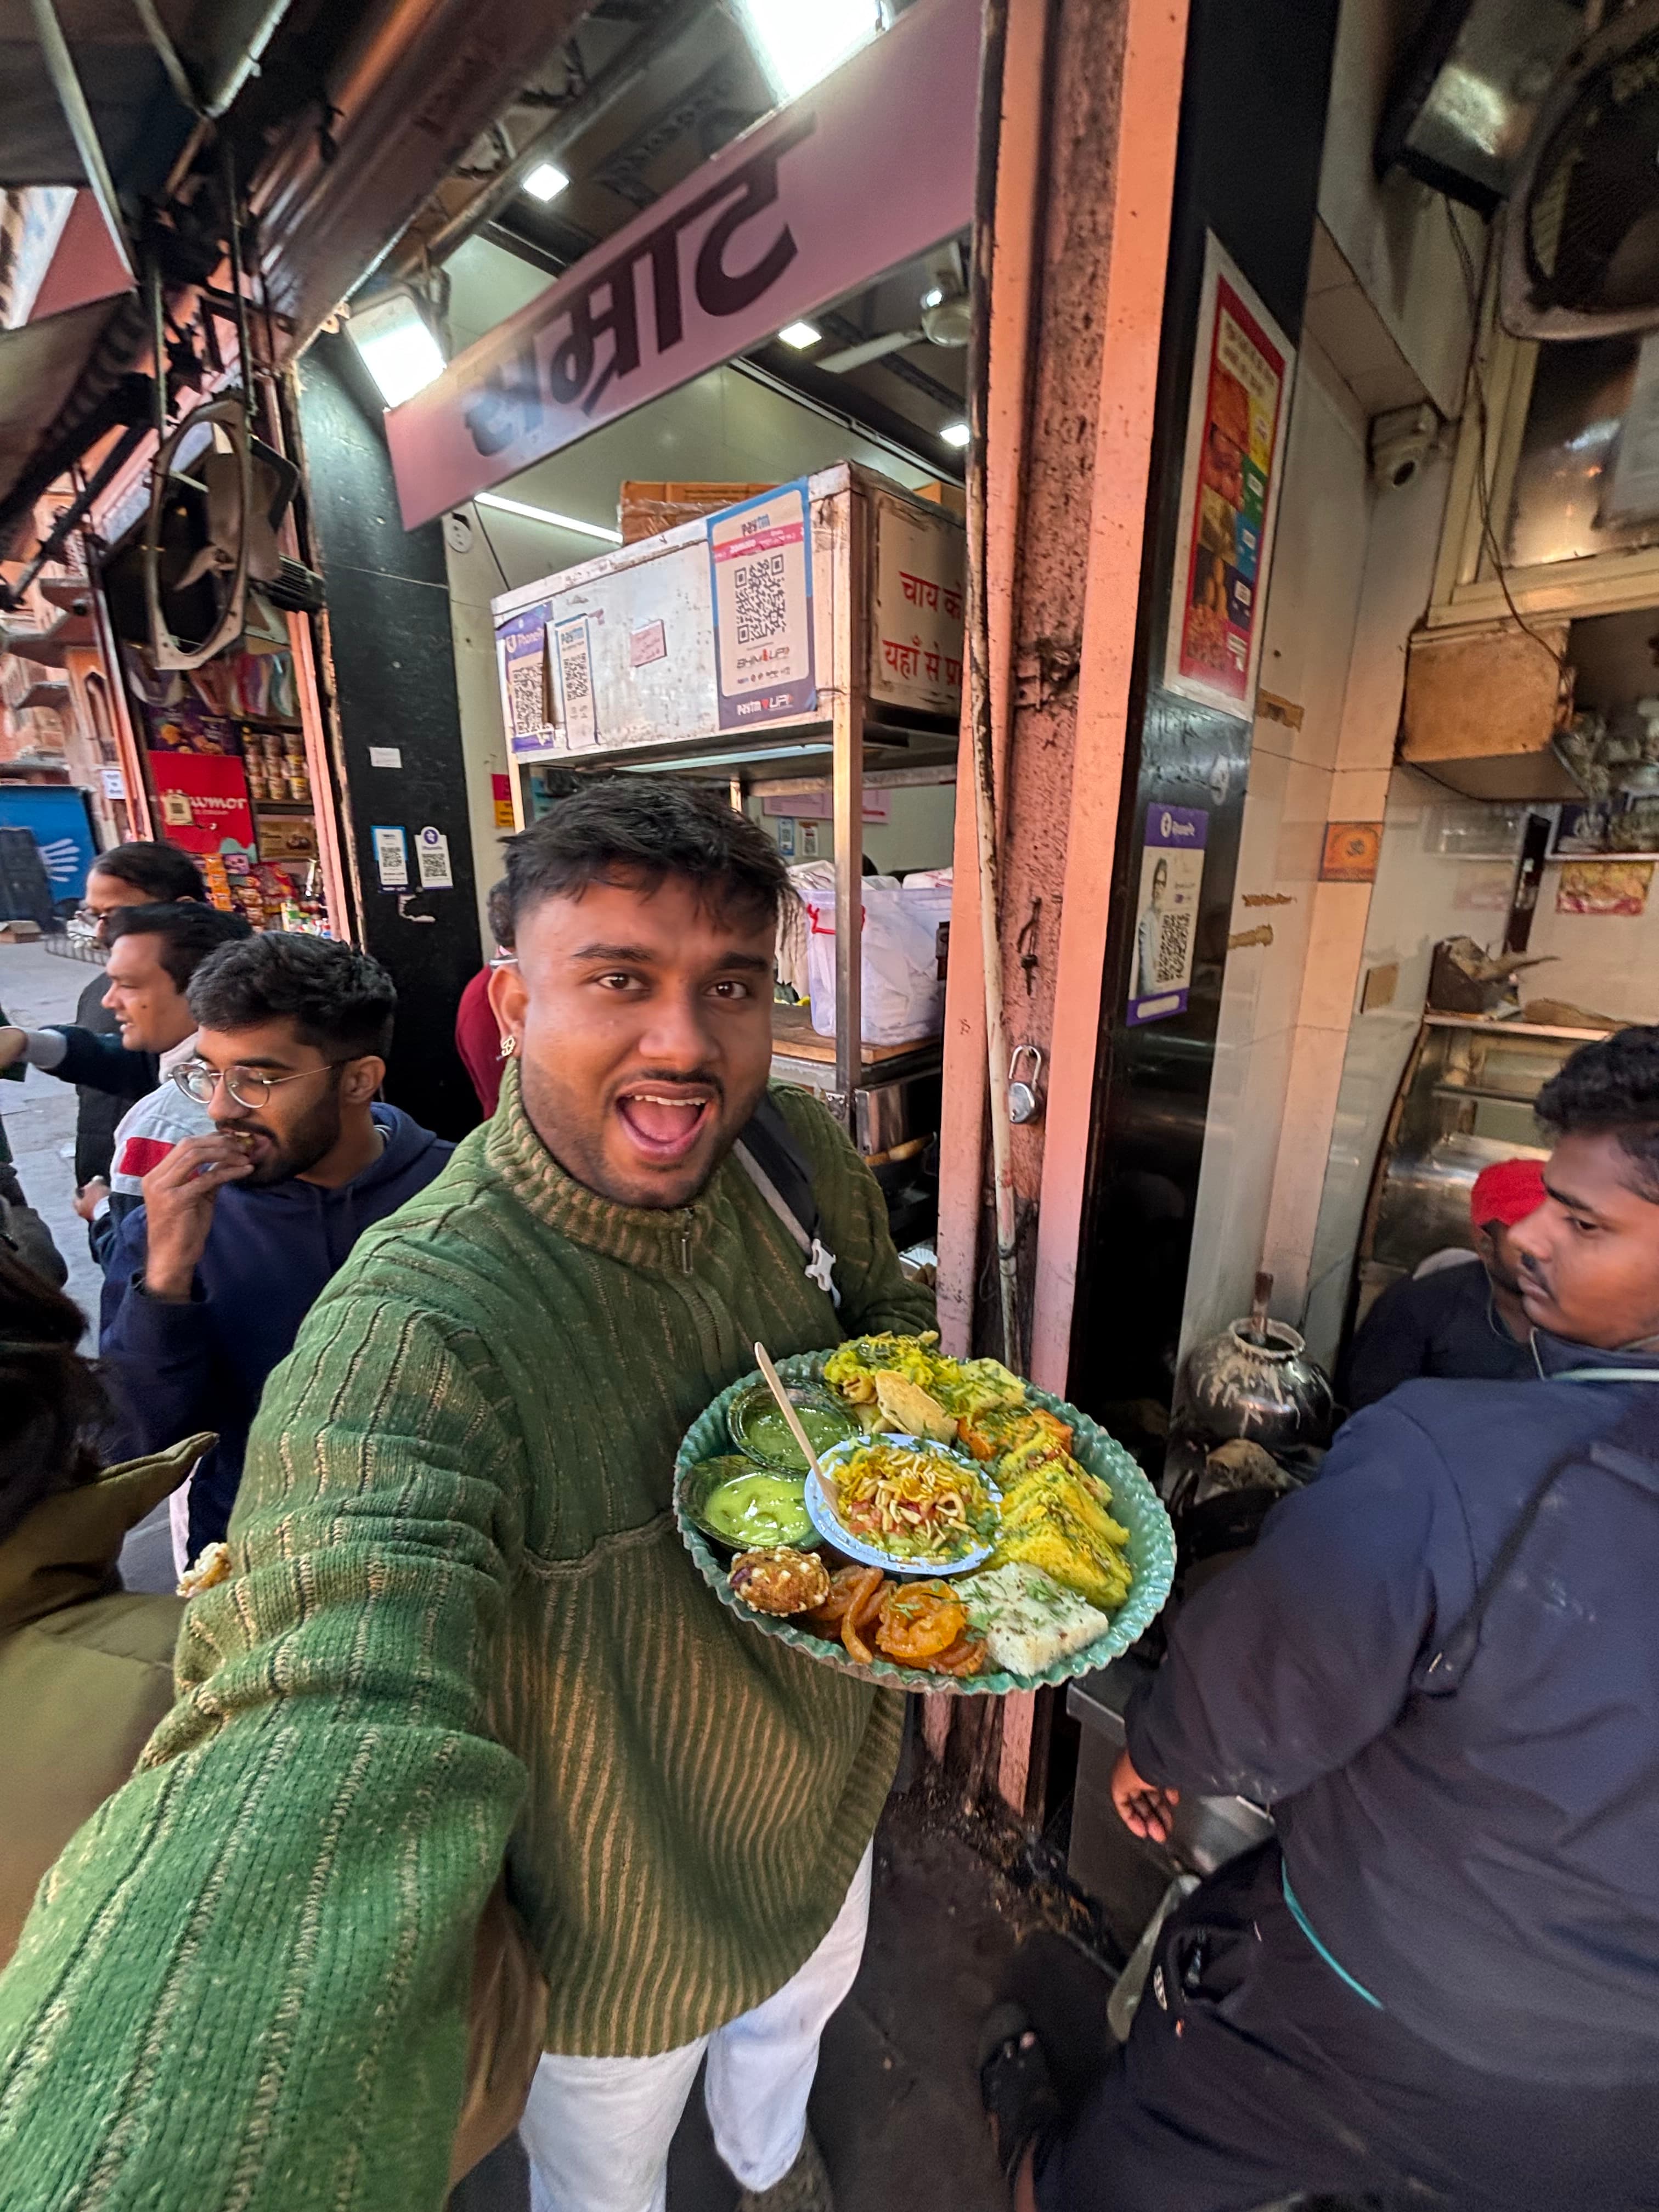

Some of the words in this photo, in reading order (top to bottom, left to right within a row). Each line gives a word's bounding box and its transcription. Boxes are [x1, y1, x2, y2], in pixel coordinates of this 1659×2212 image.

[899, 571, 940, 611] चाय
[882, 635, 922, 680] यहाँ
[924, 641, 940, 682] से
